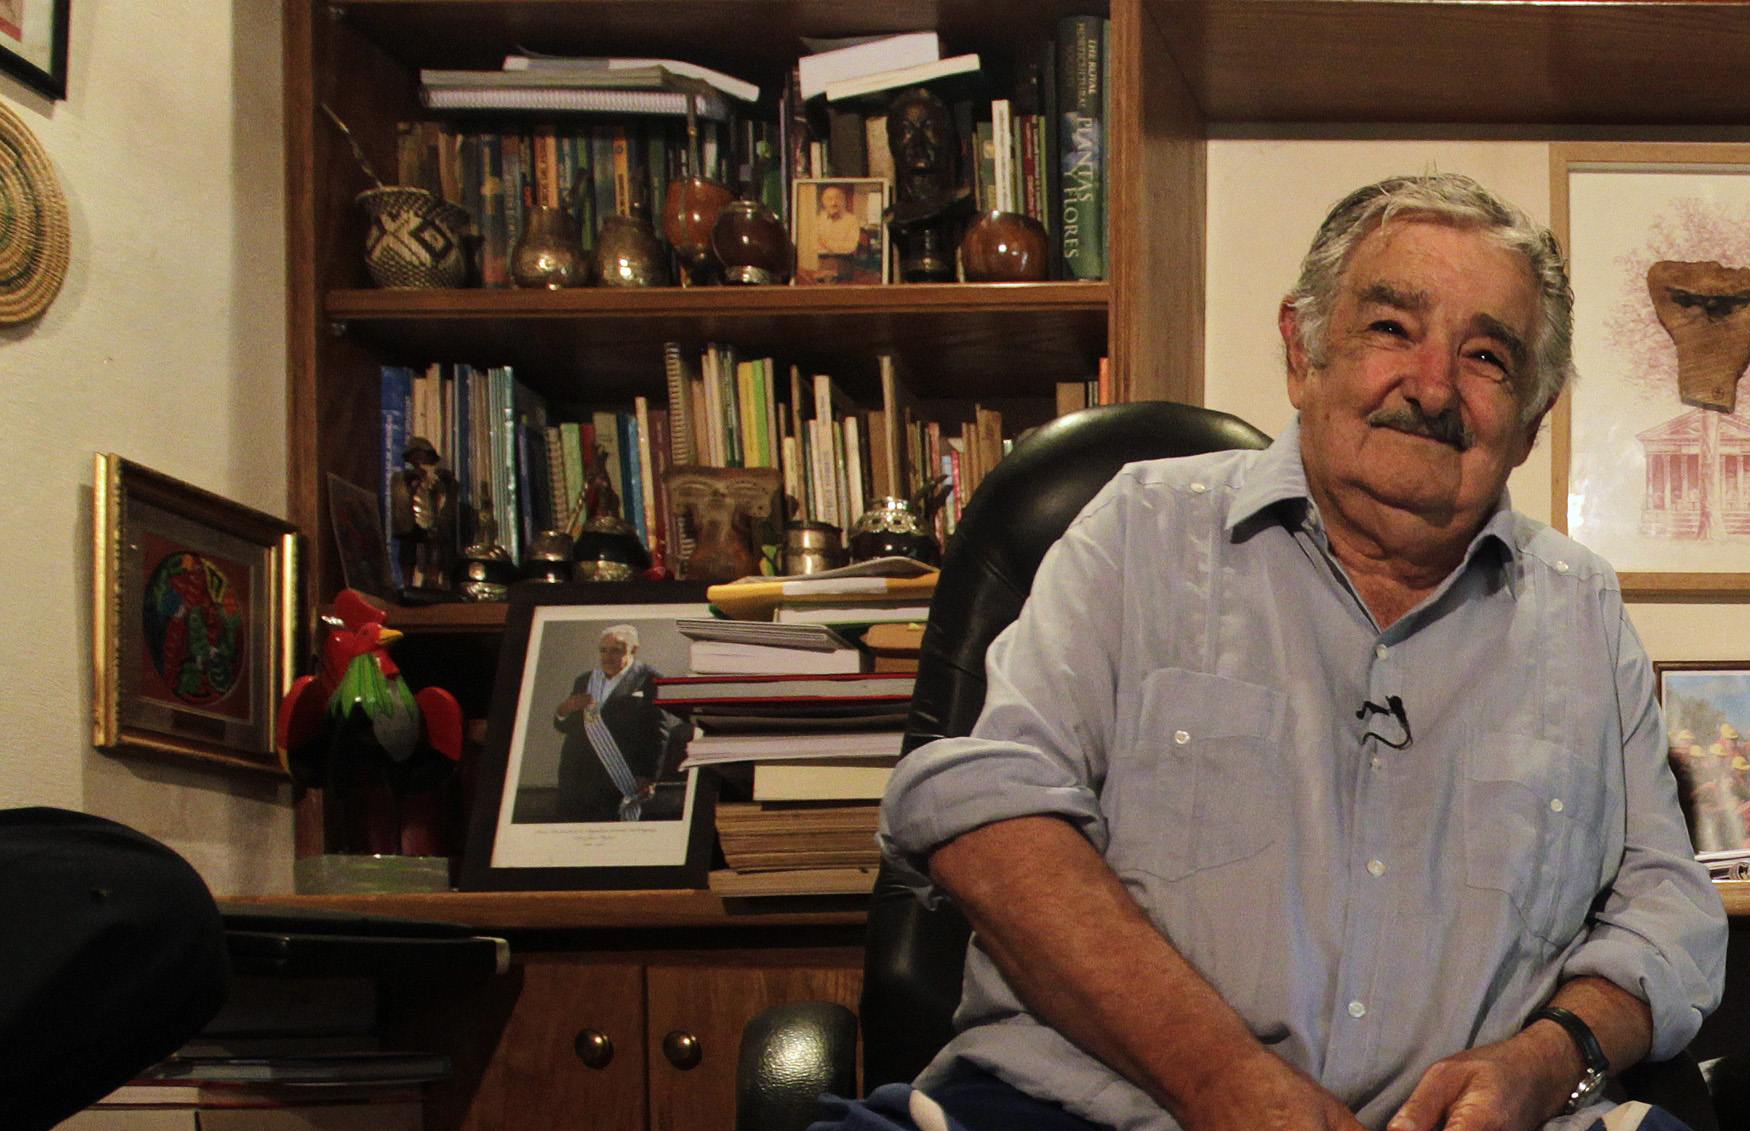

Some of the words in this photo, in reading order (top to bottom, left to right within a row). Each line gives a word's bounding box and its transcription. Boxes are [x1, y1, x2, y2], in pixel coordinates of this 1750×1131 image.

[1088, 60, 1097, 95] ROYAL
[1064, 169, 1078, 182] Y
[1077, 116, 1094, 201] PLANTAS
[1064, 186, 1079, 259] FLORES
